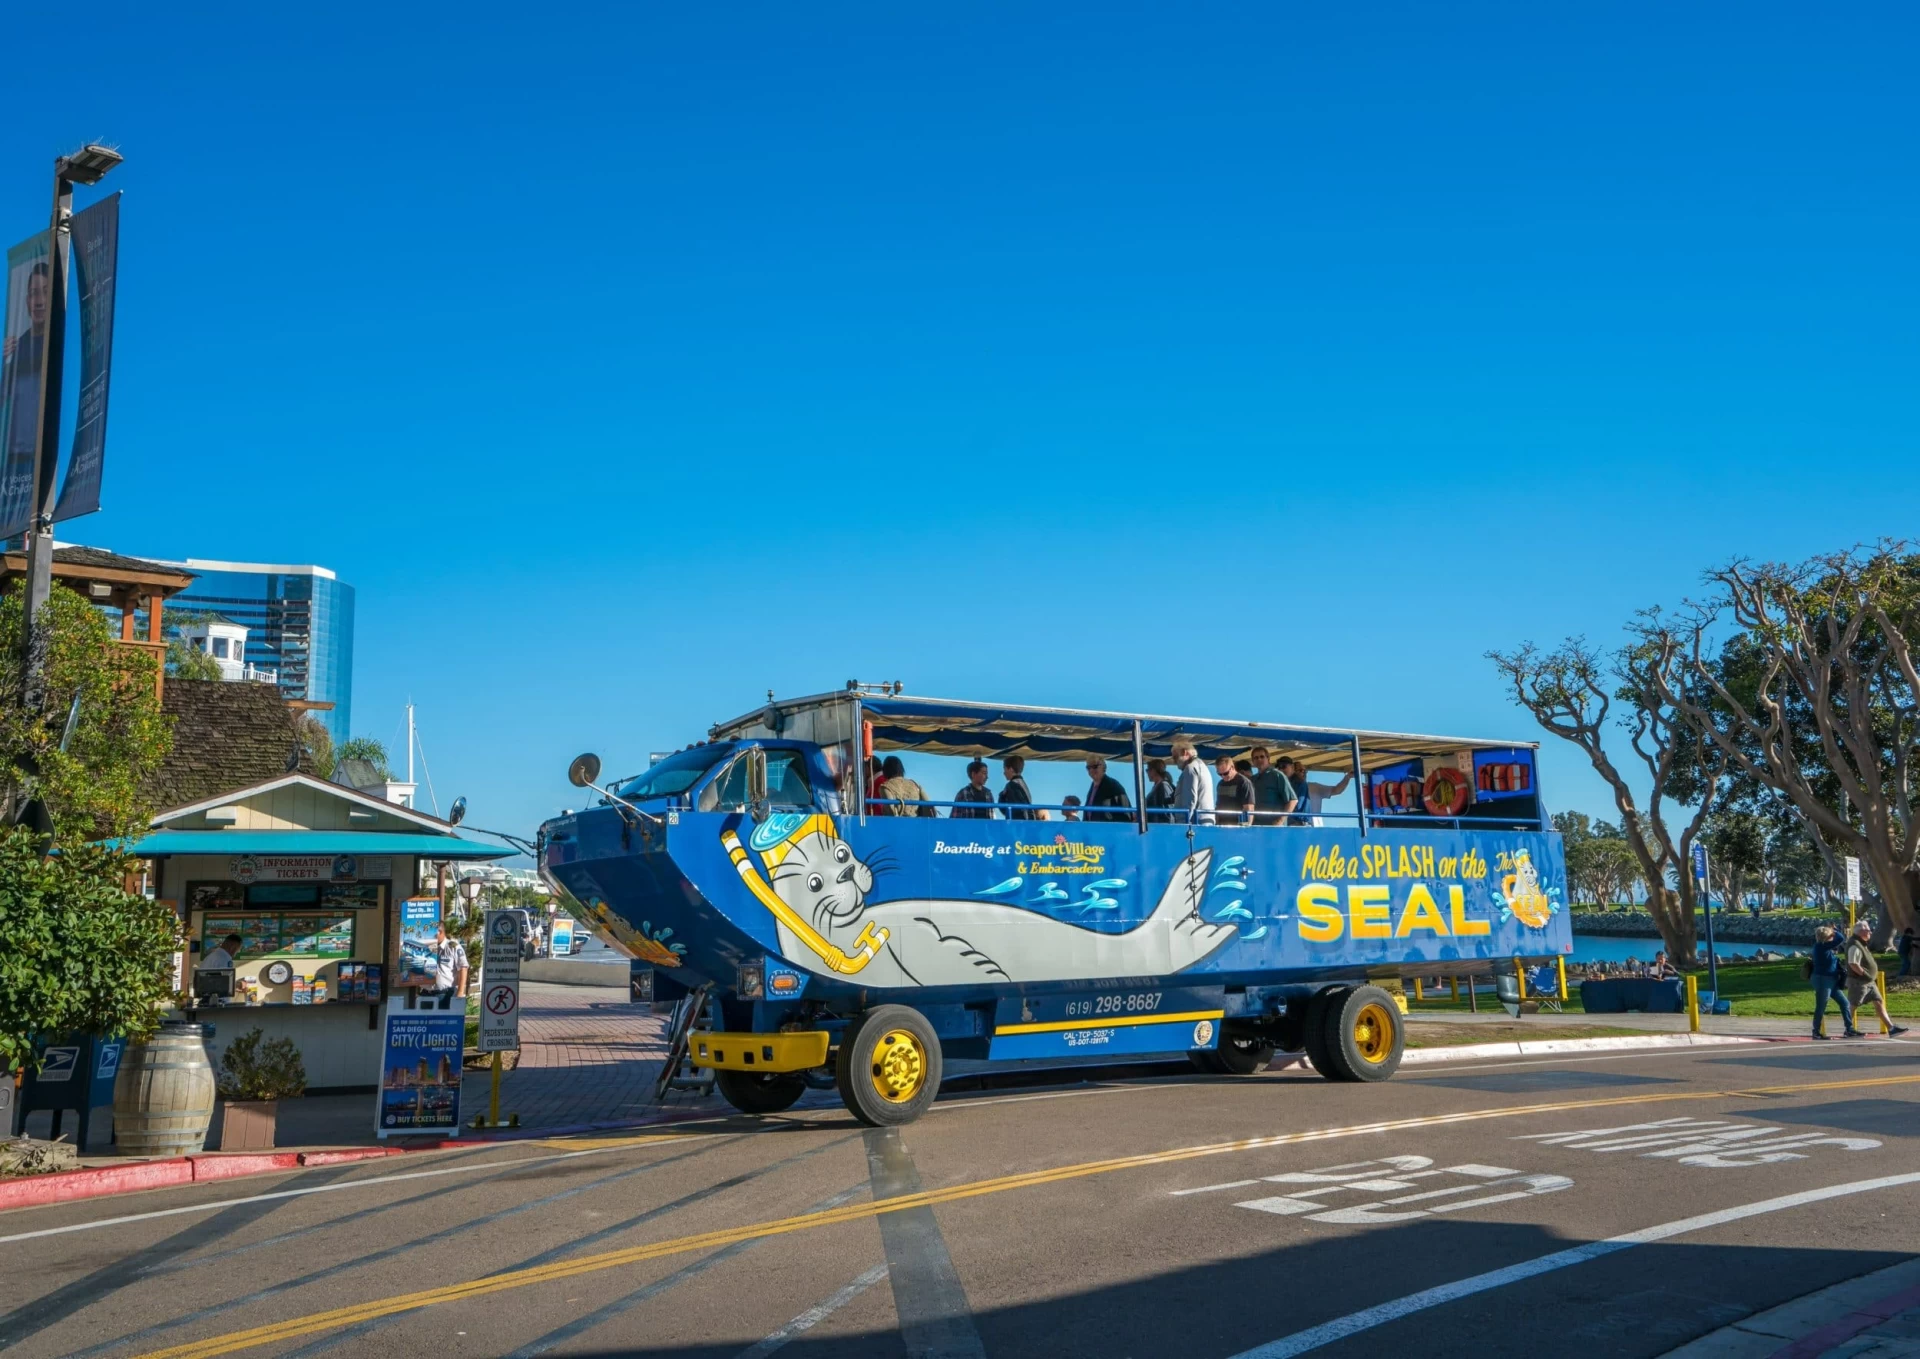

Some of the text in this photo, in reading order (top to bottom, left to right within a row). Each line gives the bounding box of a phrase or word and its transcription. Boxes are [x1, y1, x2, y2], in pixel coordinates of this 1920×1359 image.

[10, 473, 32, 484] Voices
[8, 482, 34, 497] Childr
[669, 815, 678, 824] 20
[933, 841, 1105, 861] Boarding at Seaport Village
[263, 858, 332, 867] INFORMATION
[1017, 861, 1104, 874] & Embarcadero
[1301, 844, 1487, 879] Make a SPLASH on the
[1494, 851, 1514, 872] The
[276, 869, 319, 878] TICKETS
[1516, 894, 1553, 915] SEAL
[1297, 882, 1491, 943] SEAL
[1065, 993, 1162, 1017] (619) 298-8687
[484, 1028, 516, 1036] PEDESTRIAN
[392, 1033, 458, 1048] CITY LIGHTS
[486, 1038, 513, 1047] CROSSING
[397, 1116, 411, 1124] BUY
